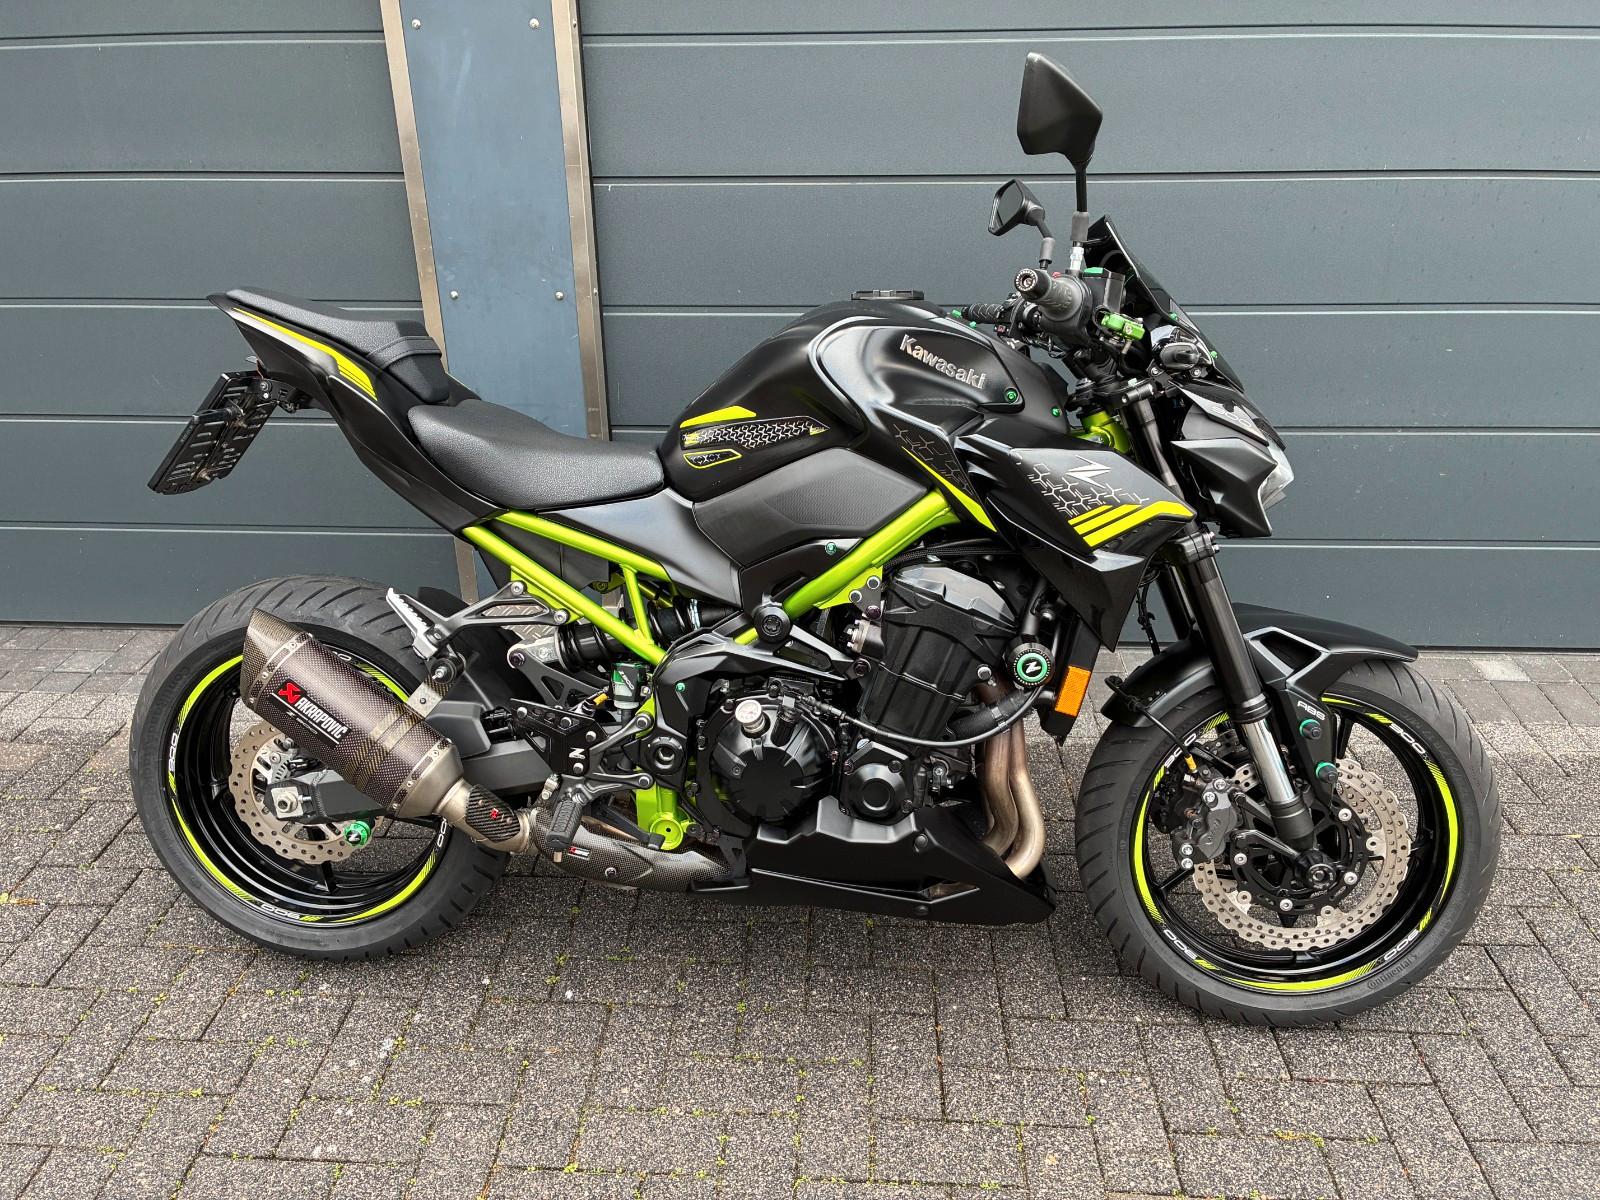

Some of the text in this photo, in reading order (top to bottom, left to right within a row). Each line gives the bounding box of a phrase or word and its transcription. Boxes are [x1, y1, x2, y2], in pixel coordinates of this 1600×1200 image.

[900, 334, 987, 389] Kawasaki
[1297, 700, 1326, 721] ABS
[1389, 722, 1426, 754] 900
[436, 817, 447, 848] 00
